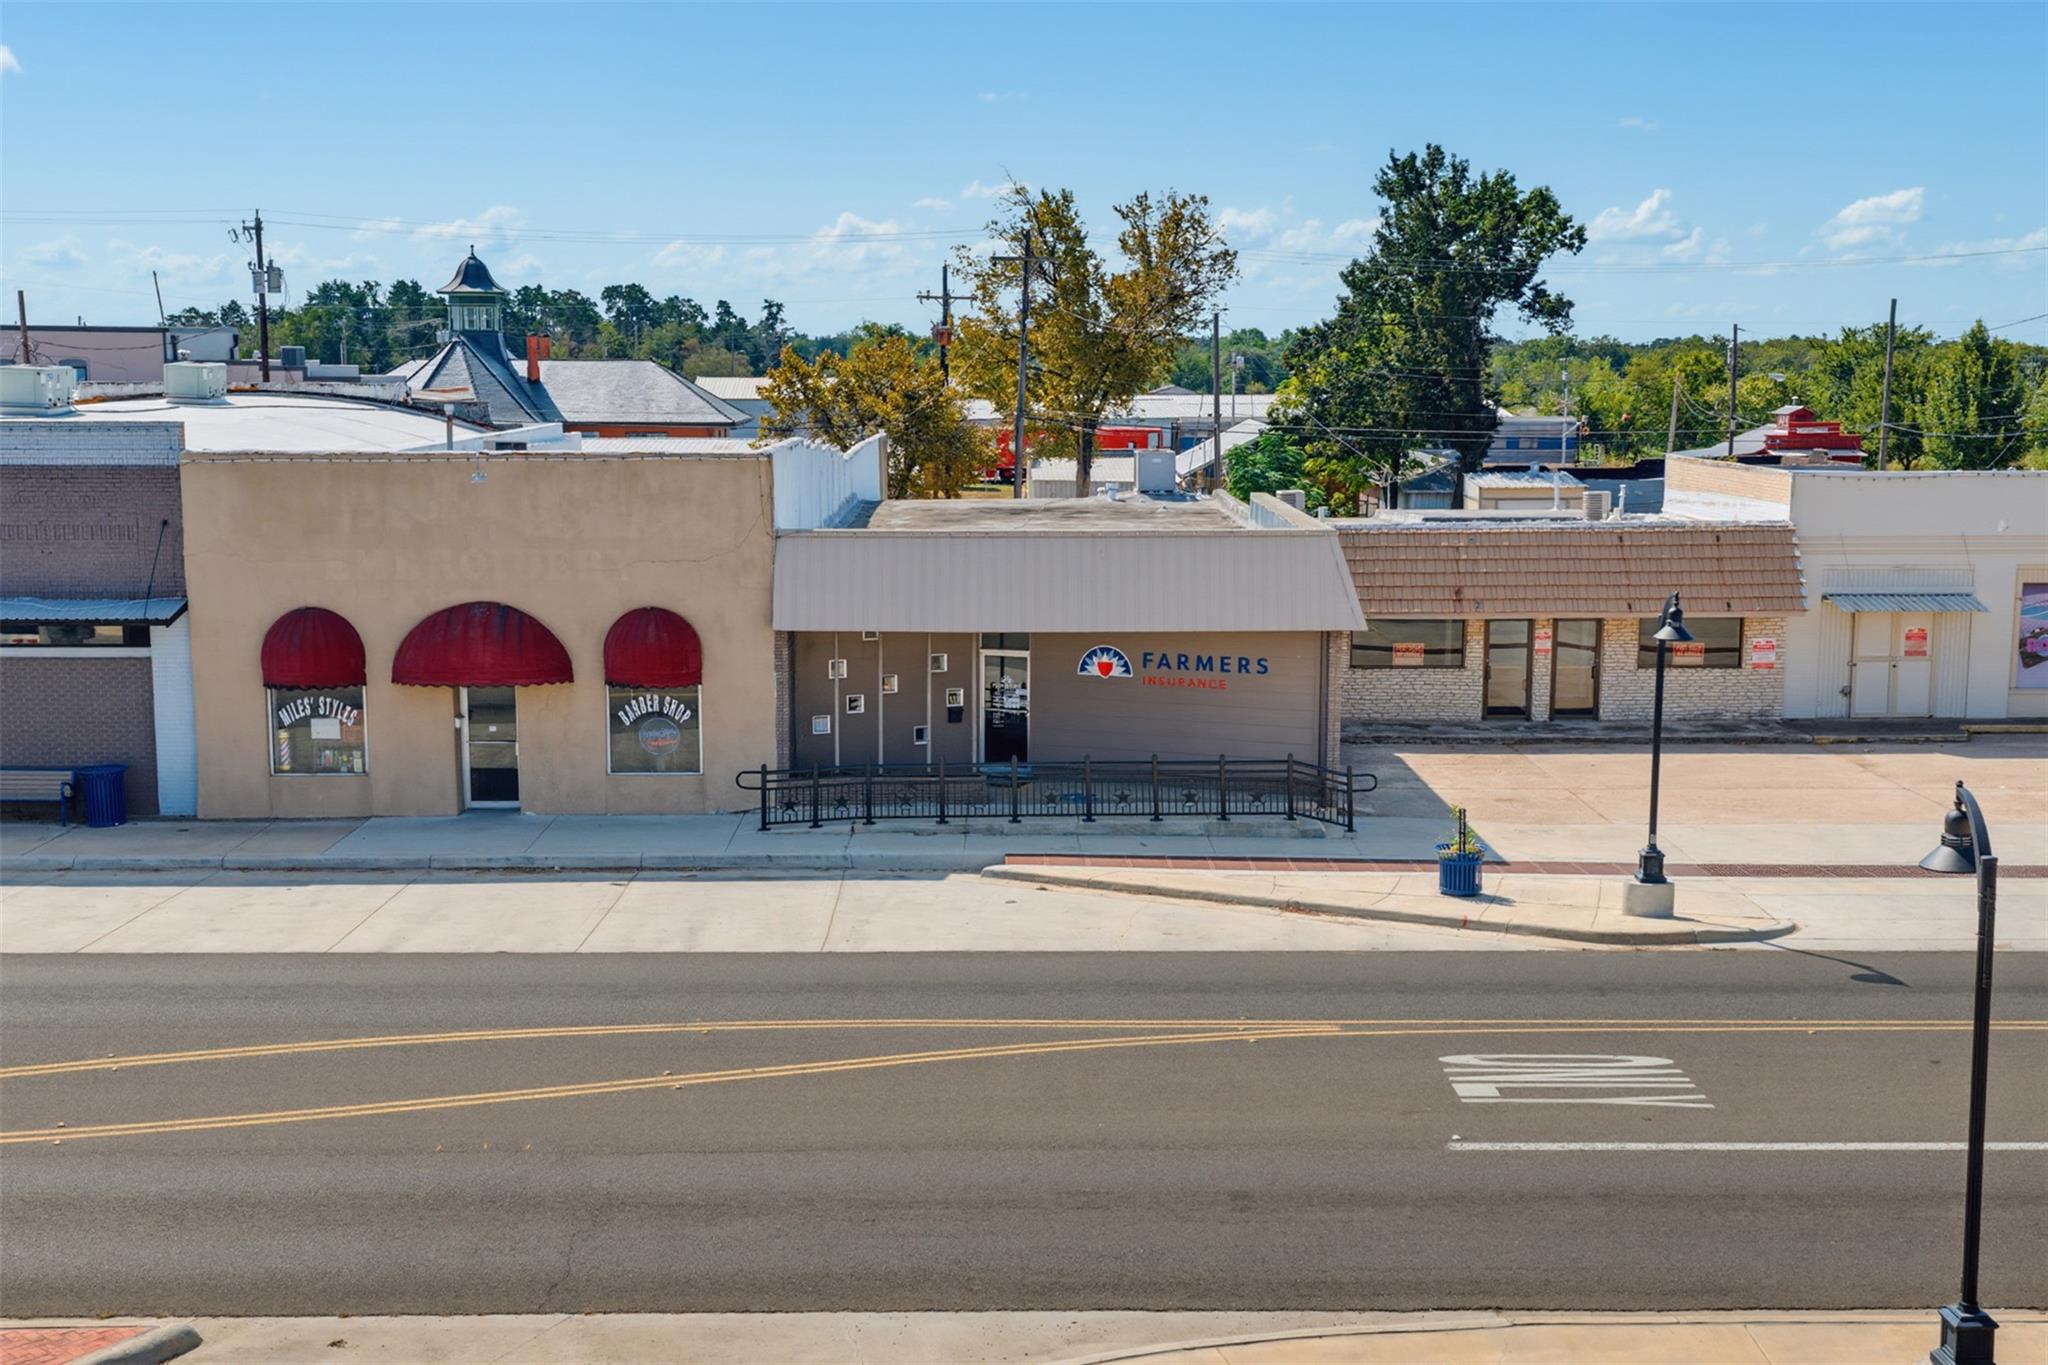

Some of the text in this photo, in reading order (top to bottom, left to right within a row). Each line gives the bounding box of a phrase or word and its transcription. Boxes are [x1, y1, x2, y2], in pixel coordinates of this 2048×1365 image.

[1141, 652, 1269, 675] FARMERS
[1141, 675, 1228, 690] INSURANCE
[318, 695, 358, 727] STYLES
[618, 693, 692, 726] BARBER SHOP
[1437, 1053, 1716, 1109] ONLY
